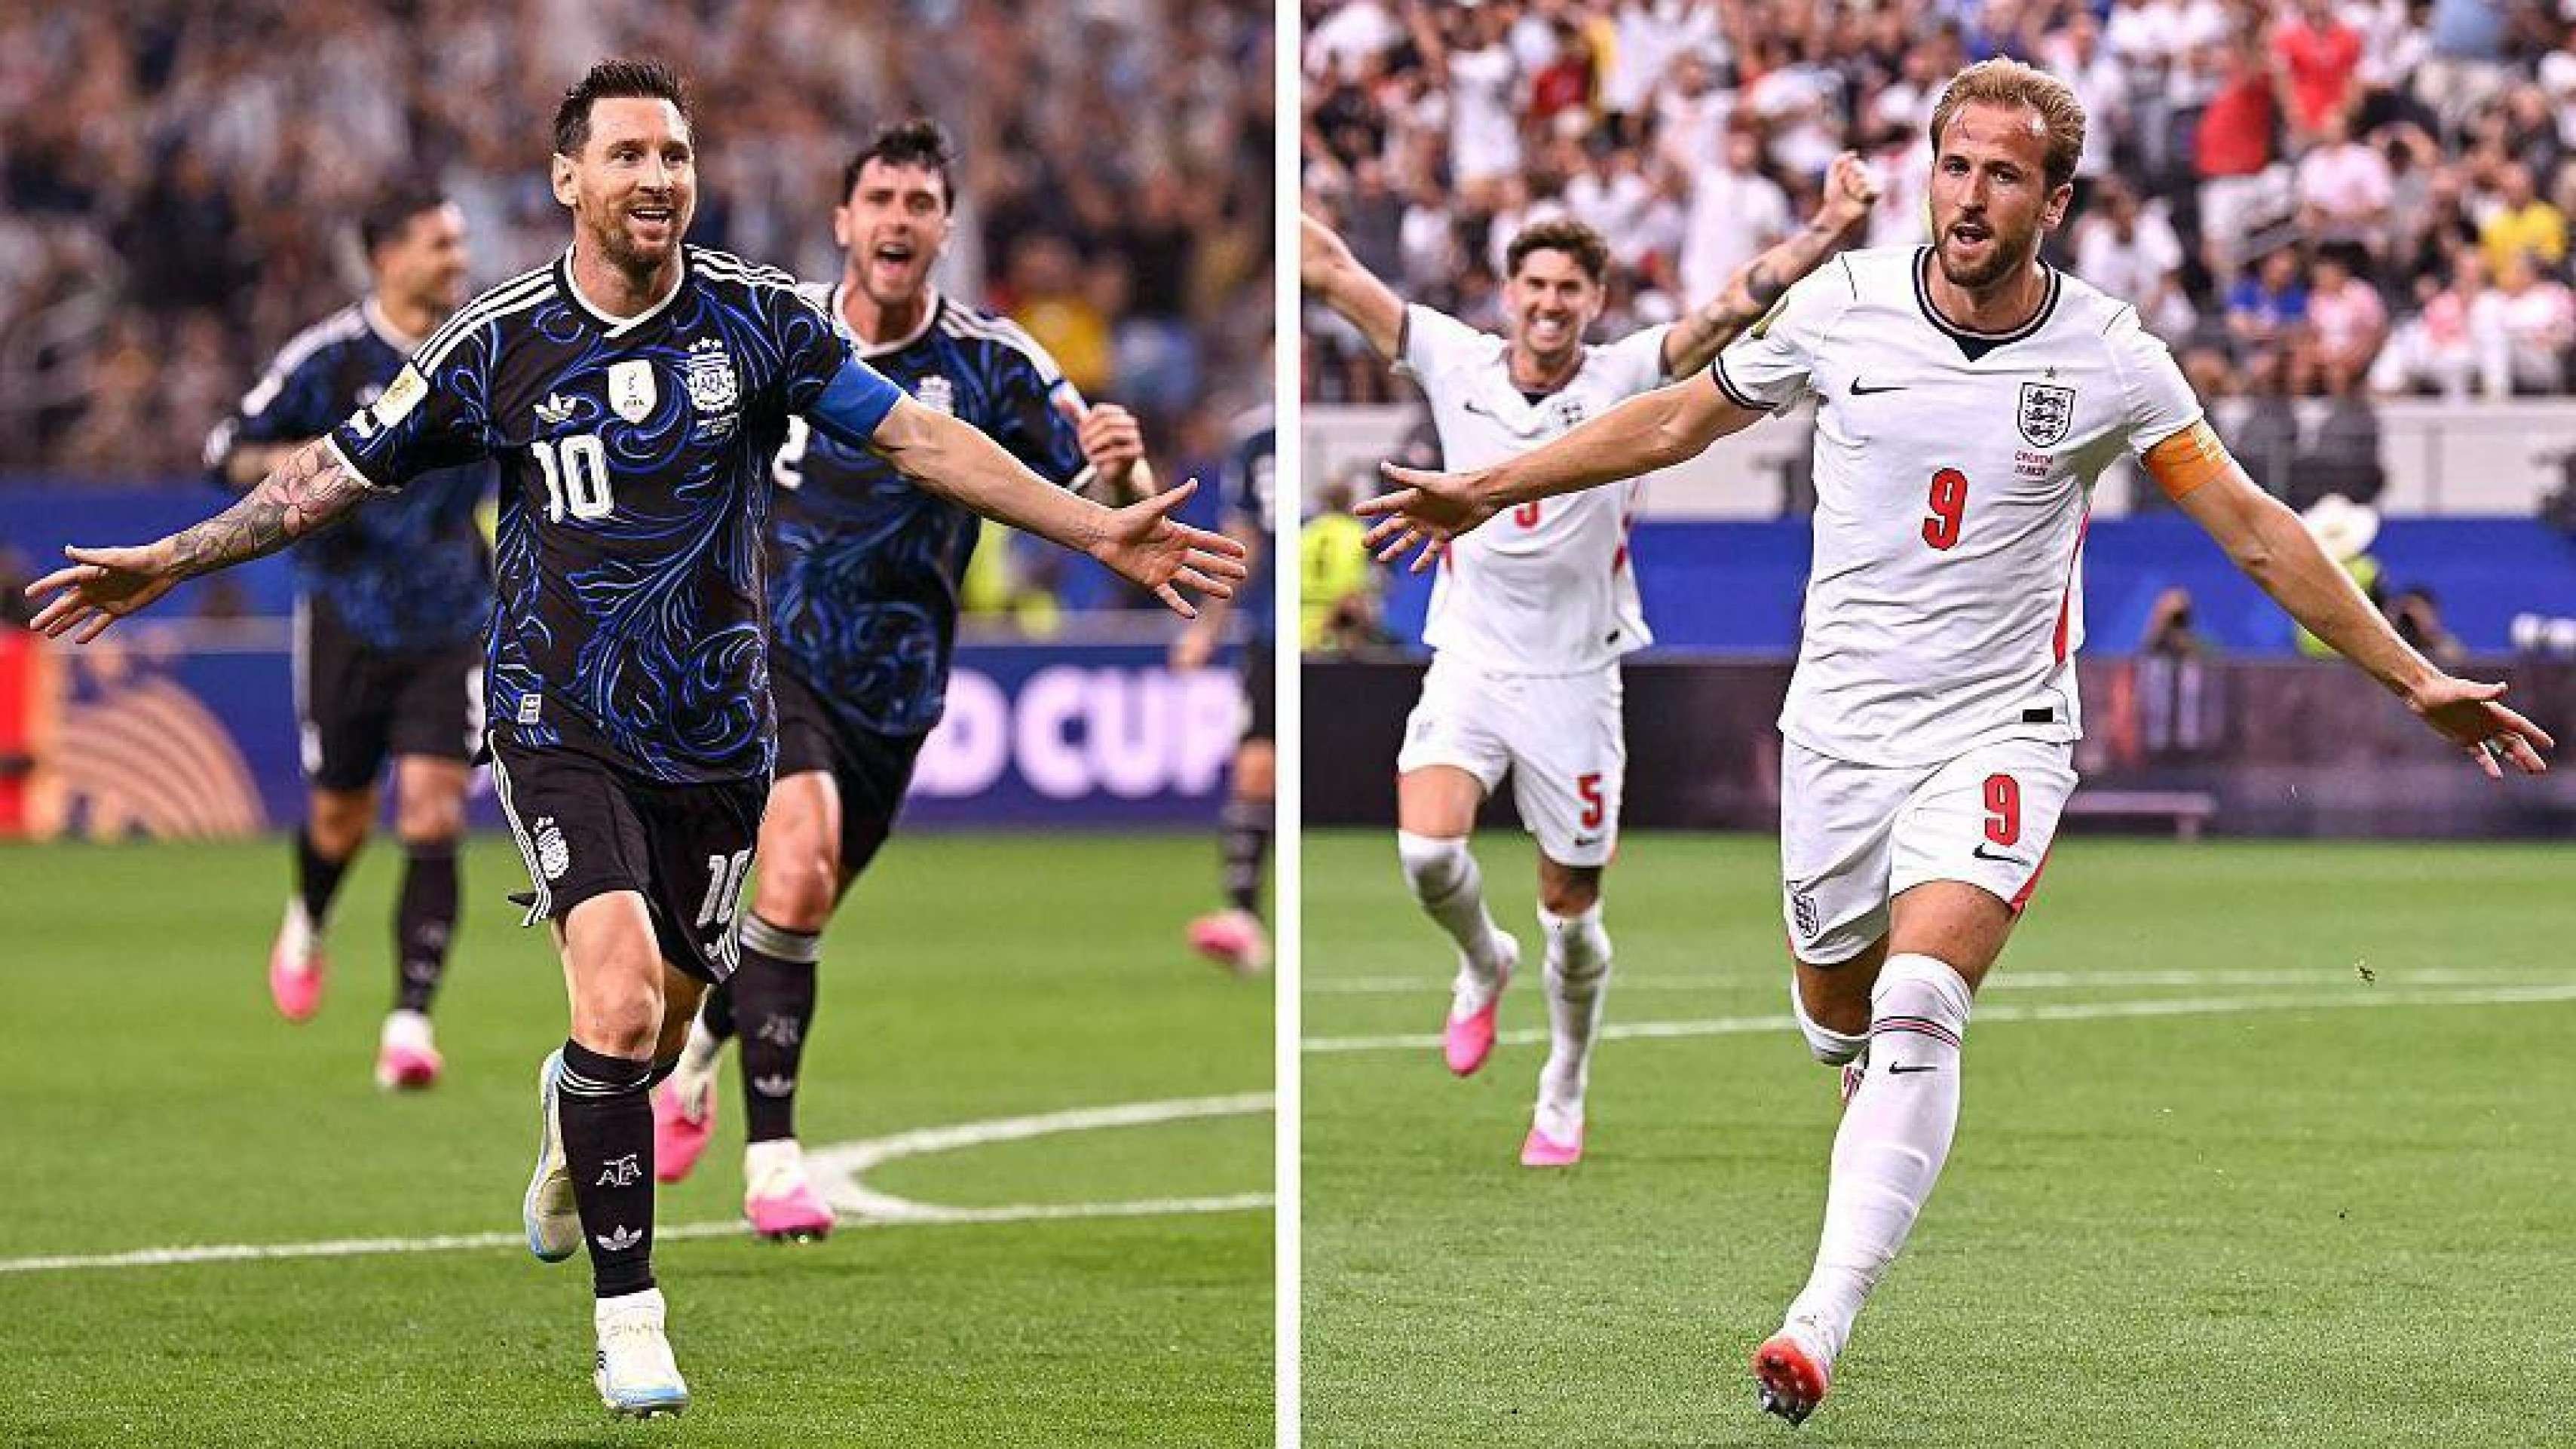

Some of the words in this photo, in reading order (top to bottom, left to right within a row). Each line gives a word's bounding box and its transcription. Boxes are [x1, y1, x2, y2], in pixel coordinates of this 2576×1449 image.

[531, 435, 614, 523] 10
[1922, 467, 1968, 551] 9
[1013, 665, 1253, 799] CUP
[1576, 773, 1603, 829] 5
[1983, 773, 2020, 847] 9
